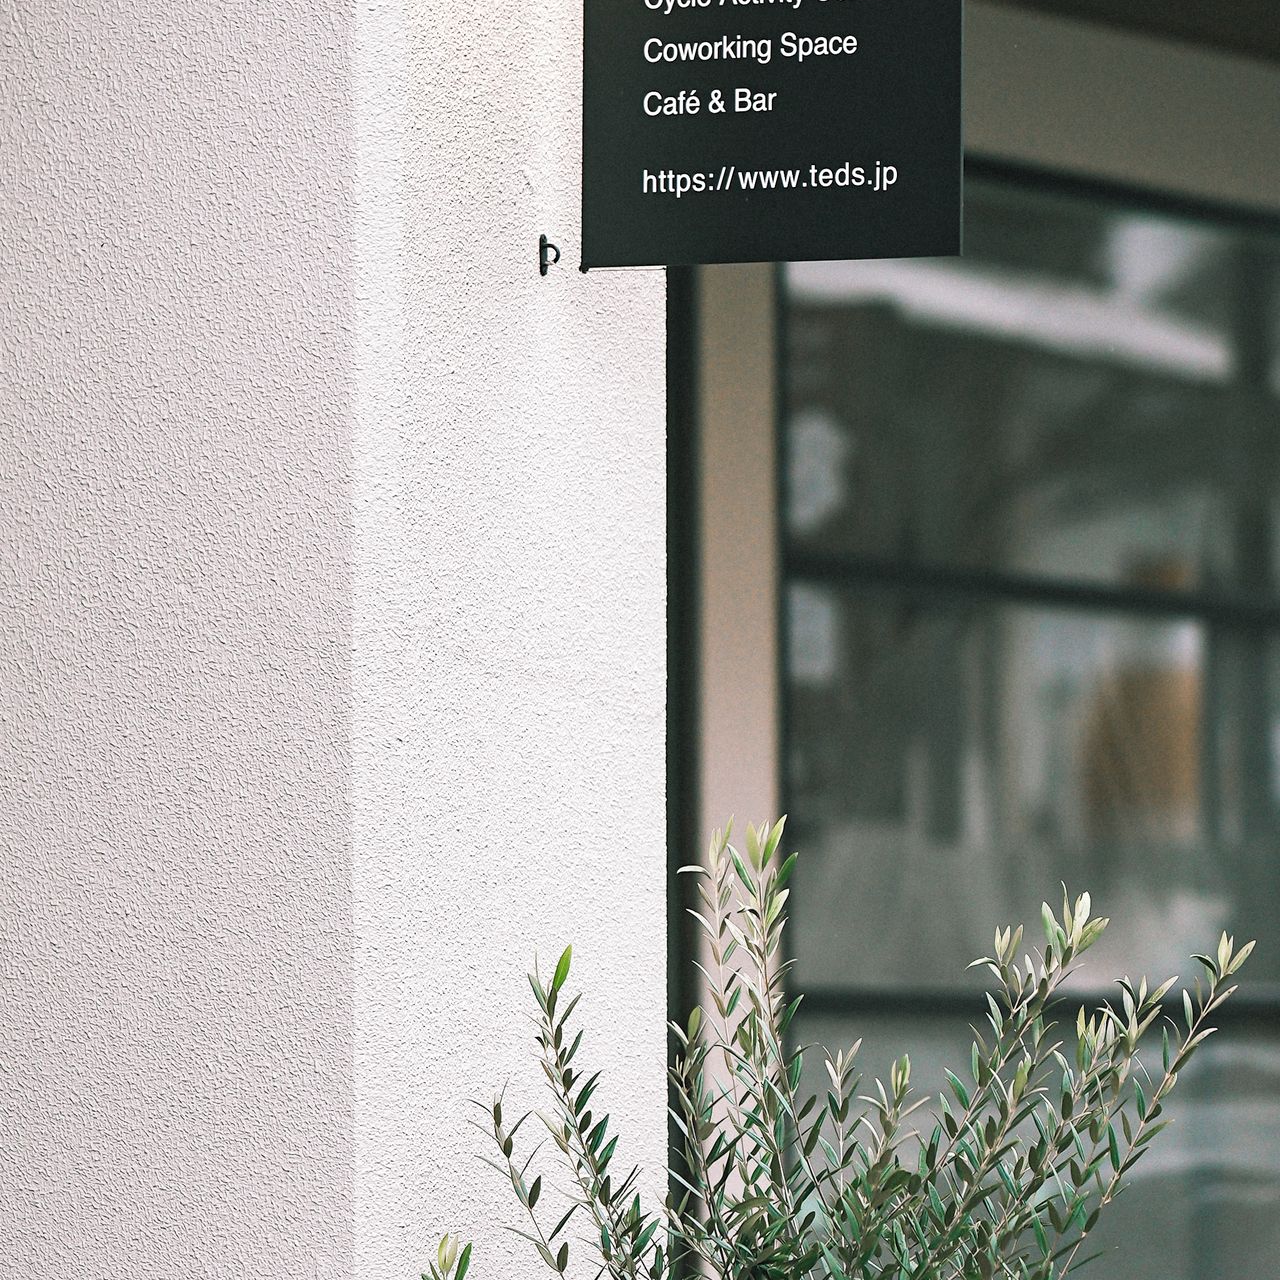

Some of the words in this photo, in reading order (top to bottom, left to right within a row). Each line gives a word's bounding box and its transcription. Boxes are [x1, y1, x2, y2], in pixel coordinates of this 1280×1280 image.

[643, 34, 773, 65] Coworking
[780, 31, 858, 63] Space
[643, 89, 702, 117] Café
[708, 89, 728, 114] &
[734, 87, 779, 113] Bar
[642, 159, 899, 199] https://www.teds.jp
